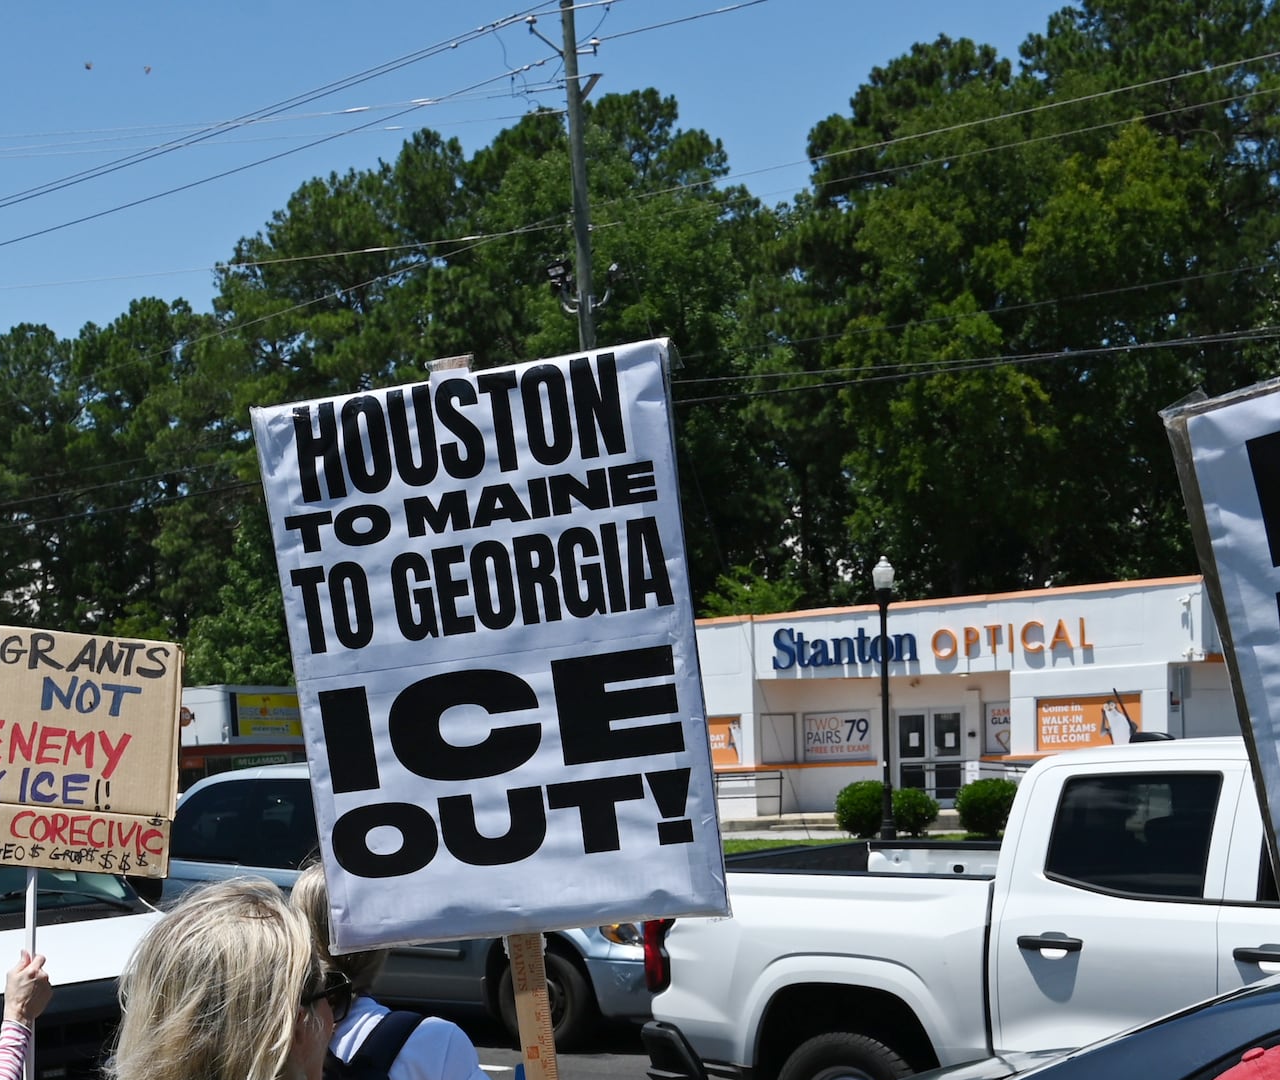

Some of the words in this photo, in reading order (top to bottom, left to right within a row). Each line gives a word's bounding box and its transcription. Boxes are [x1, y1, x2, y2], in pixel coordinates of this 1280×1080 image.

[293, 353, 626, 503] HOUSTON
[285, 504, 391, 553] TO
[404, 461, 657, 538] MAINE
[290, 561, 373, 654] TO
[390, 516, 674, 641] GEORGIA
[772, 627, 917, 670] Stanton
[931, 617, 1094, 661] OPTICAL
[41, 675, 141, 717] NOT
[1042, 703, 1068, 712] Come
[316, 645, 686, 794] ICE
[807, 717, 839, 730] TWO
[807, 730, 841, 744] PAIRS
[1042, 715, 1082, 725] WALK-IN
[1042, 725, 1059, 734] EYE
[1062, 723, 1096, 733] EXAMS
[1042, 733, 1090, 744] WELCOME
[10, 811, 163, 856] CORECIVIC
[331, 767, 694, 879] OUT!
